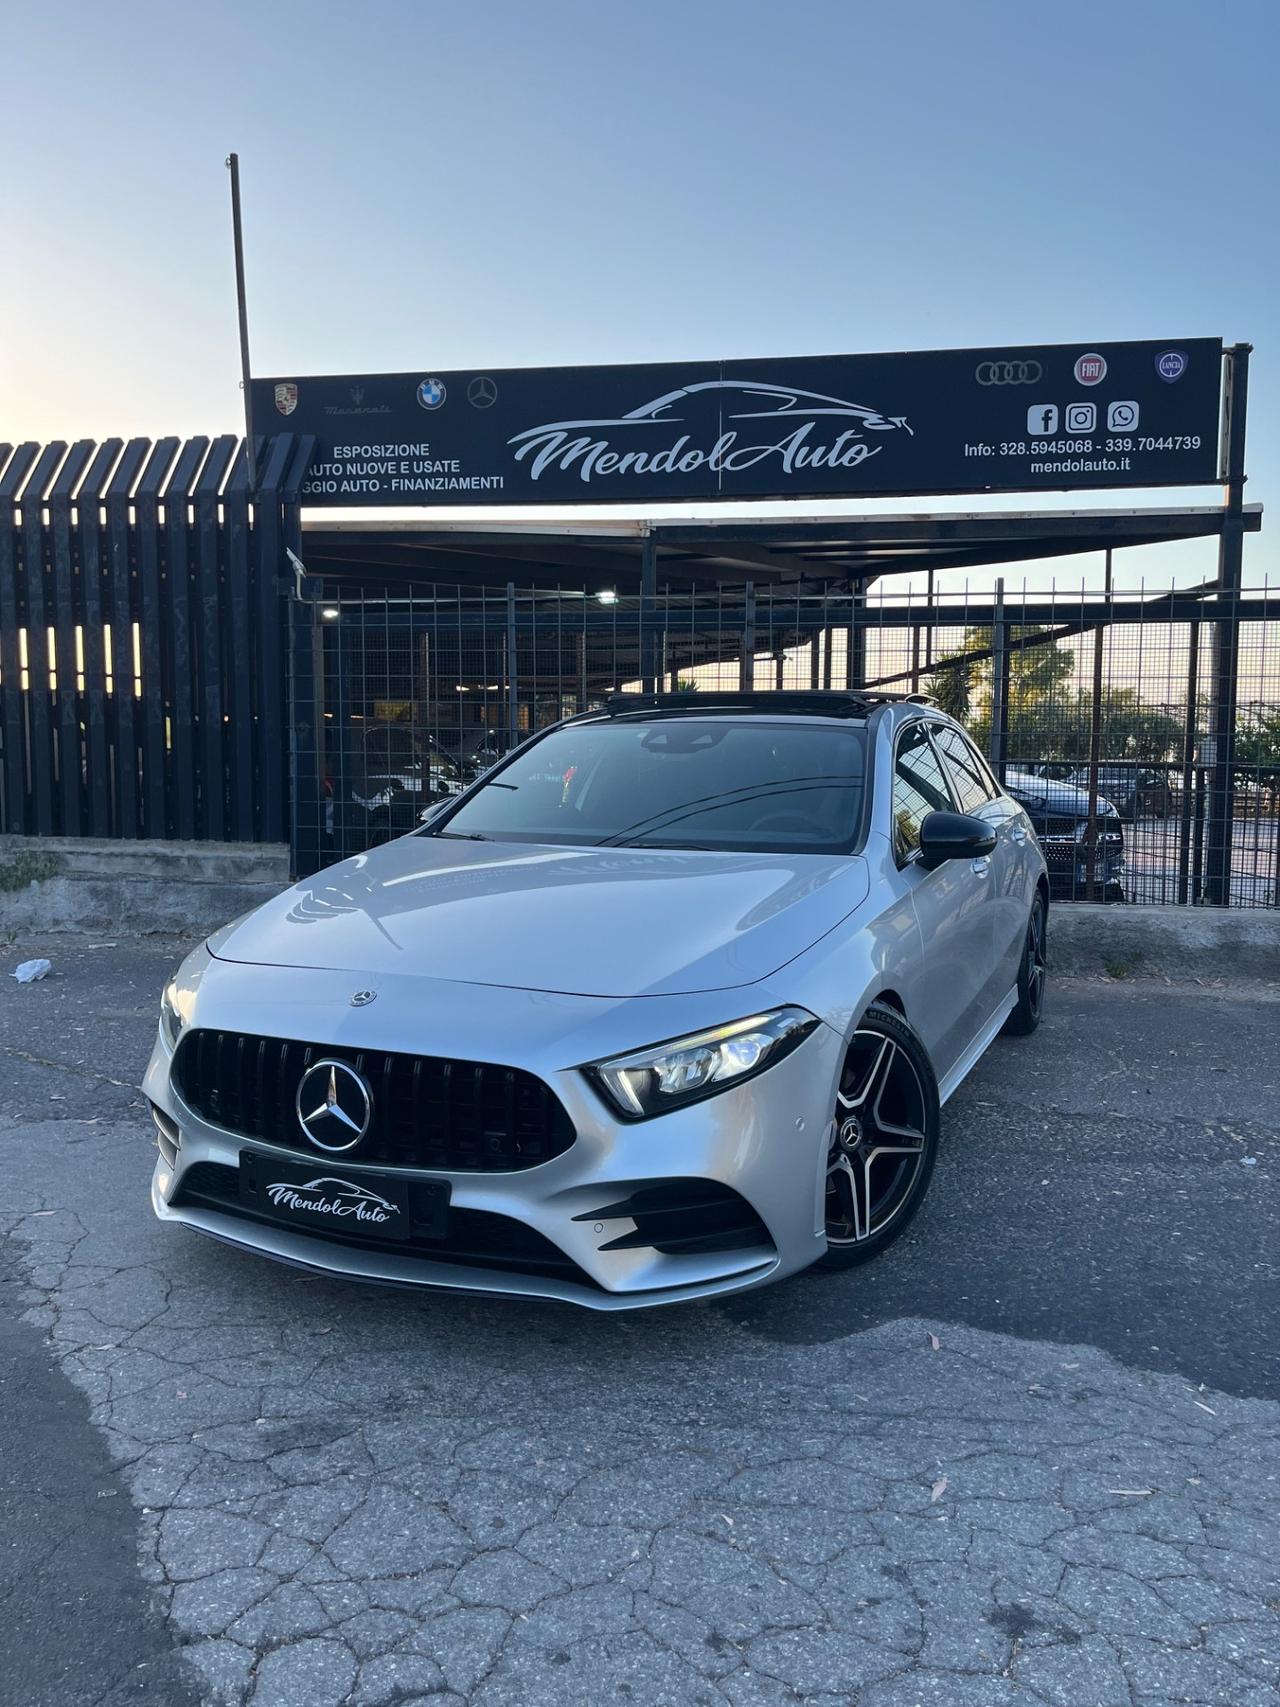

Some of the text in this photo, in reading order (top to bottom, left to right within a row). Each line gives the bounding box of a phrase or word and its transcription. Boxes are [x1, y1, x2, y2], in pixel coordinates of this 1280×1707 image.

[1081, 362, 1100, 377] FIAT
[333, 444, 429, 459] ESPOSIZIONE
[964, 443, 996, 457] Info:
[999, 440, 1093, 455] 328.5945068
[1105, 435, 1201, 452] 339.7044739
[346, 461, 397, 475] NUOVE
[400, 461, 410, 474] E
[413, 460, 460, 473] USATE
[1030, 457, 1131, 473] mendolauto.it
[340, 479, 380, 492] AUTO
[391, 476, 504, 491] FINANZIAMENTI
